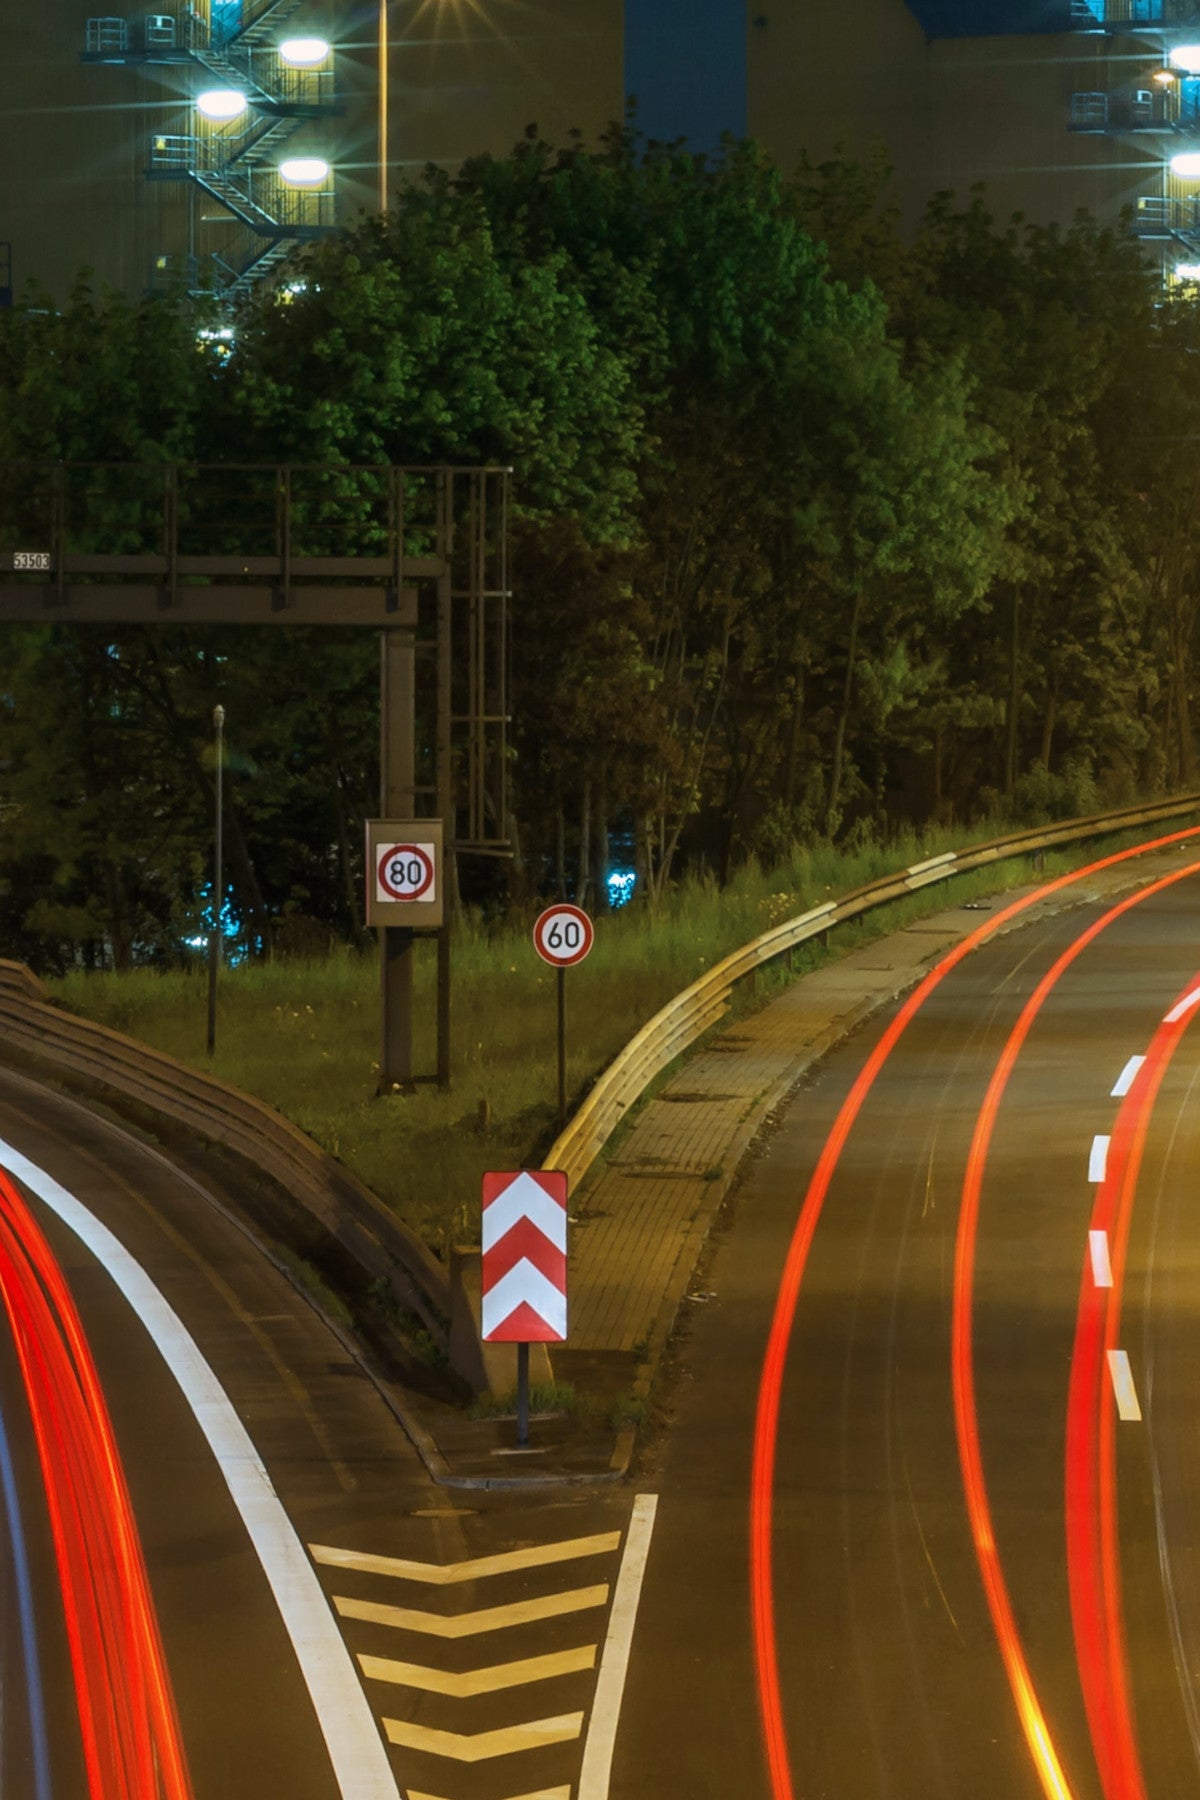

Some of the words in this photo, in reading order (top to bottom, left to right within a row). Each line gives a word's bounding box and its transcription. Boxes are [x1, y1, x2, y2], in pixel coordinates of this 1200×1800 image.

[14, 554, 49, 568] 53503
[390, 860, 421, 885] 80
[547, 922, 579, 949] 60
